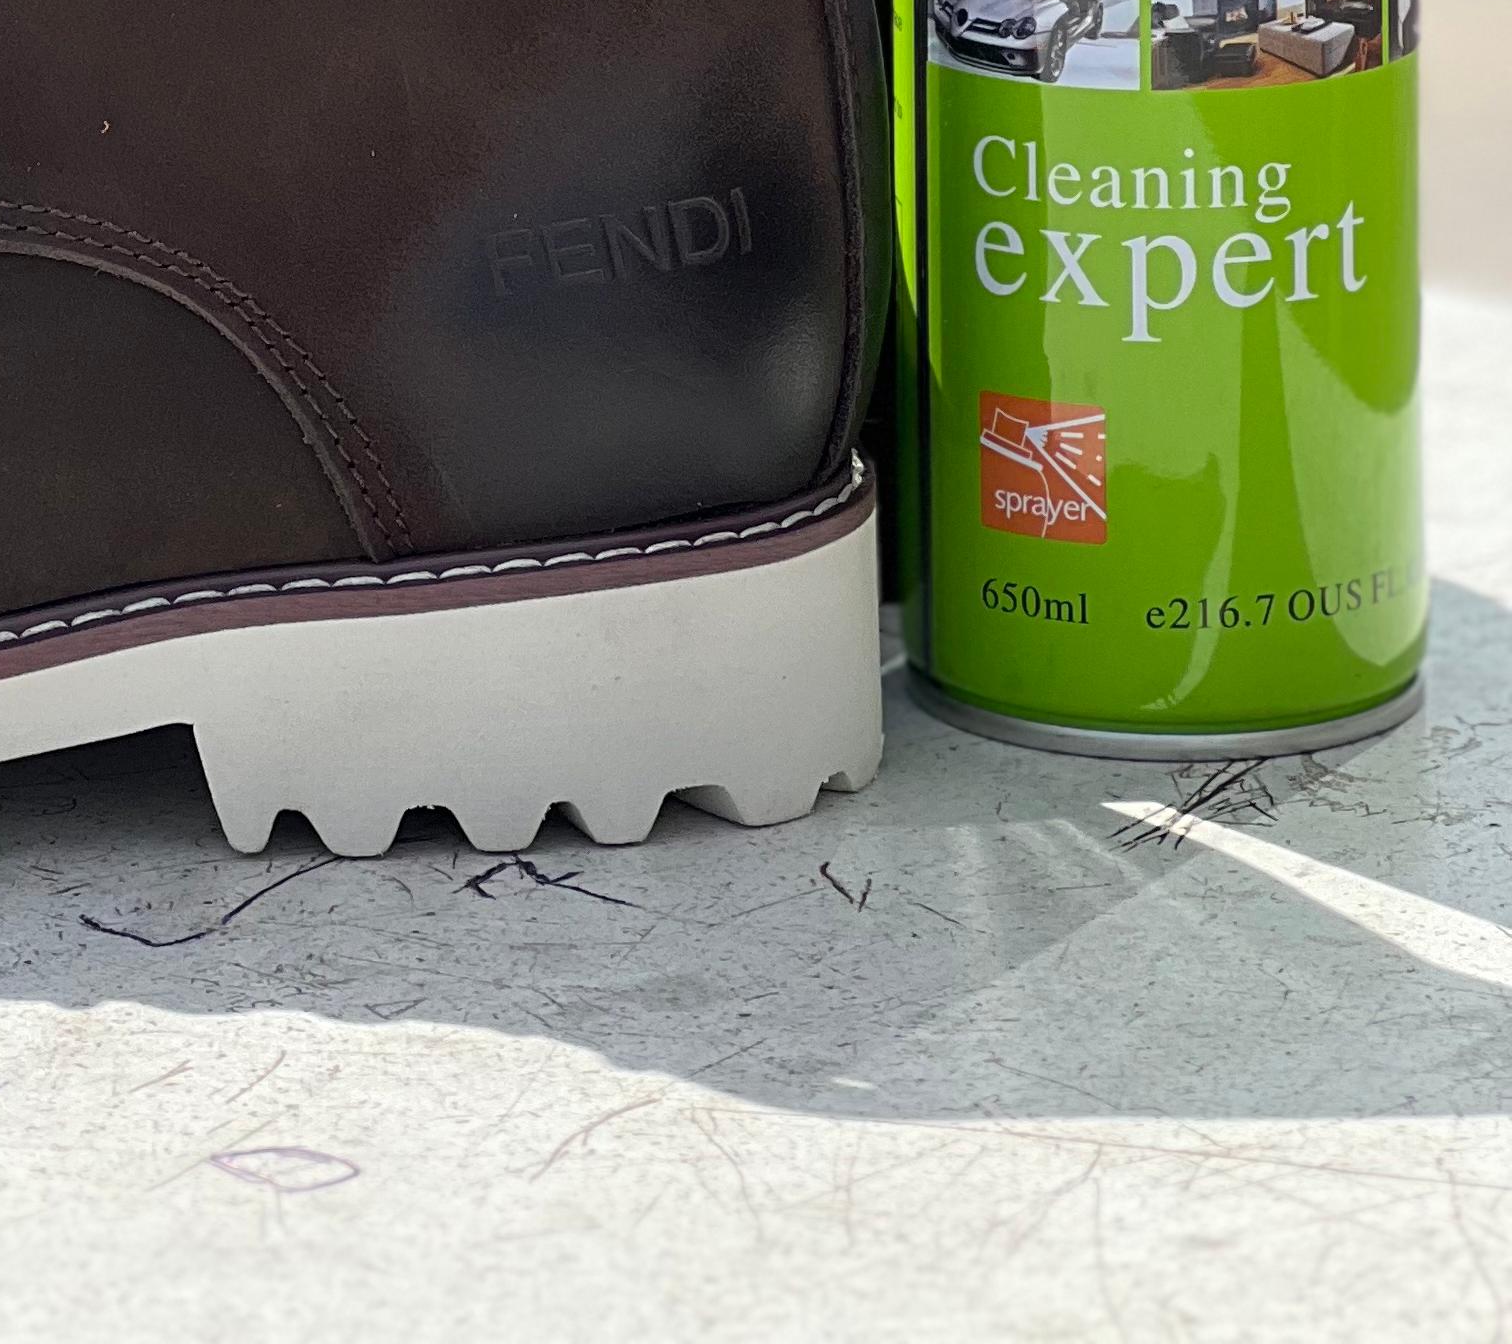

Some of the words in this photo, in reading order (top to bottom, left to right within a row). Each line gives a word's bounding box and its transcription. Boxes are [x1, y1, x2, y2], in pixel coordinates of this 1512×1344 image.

[972, 135, 1292, 223] Cleaning
[491, 187, 753, 297] FENDI
[974, 199, 1368, 343] expert
[994, 486, 1092, 523] sprayer
[981, 577, 1090, 626] 650ml
